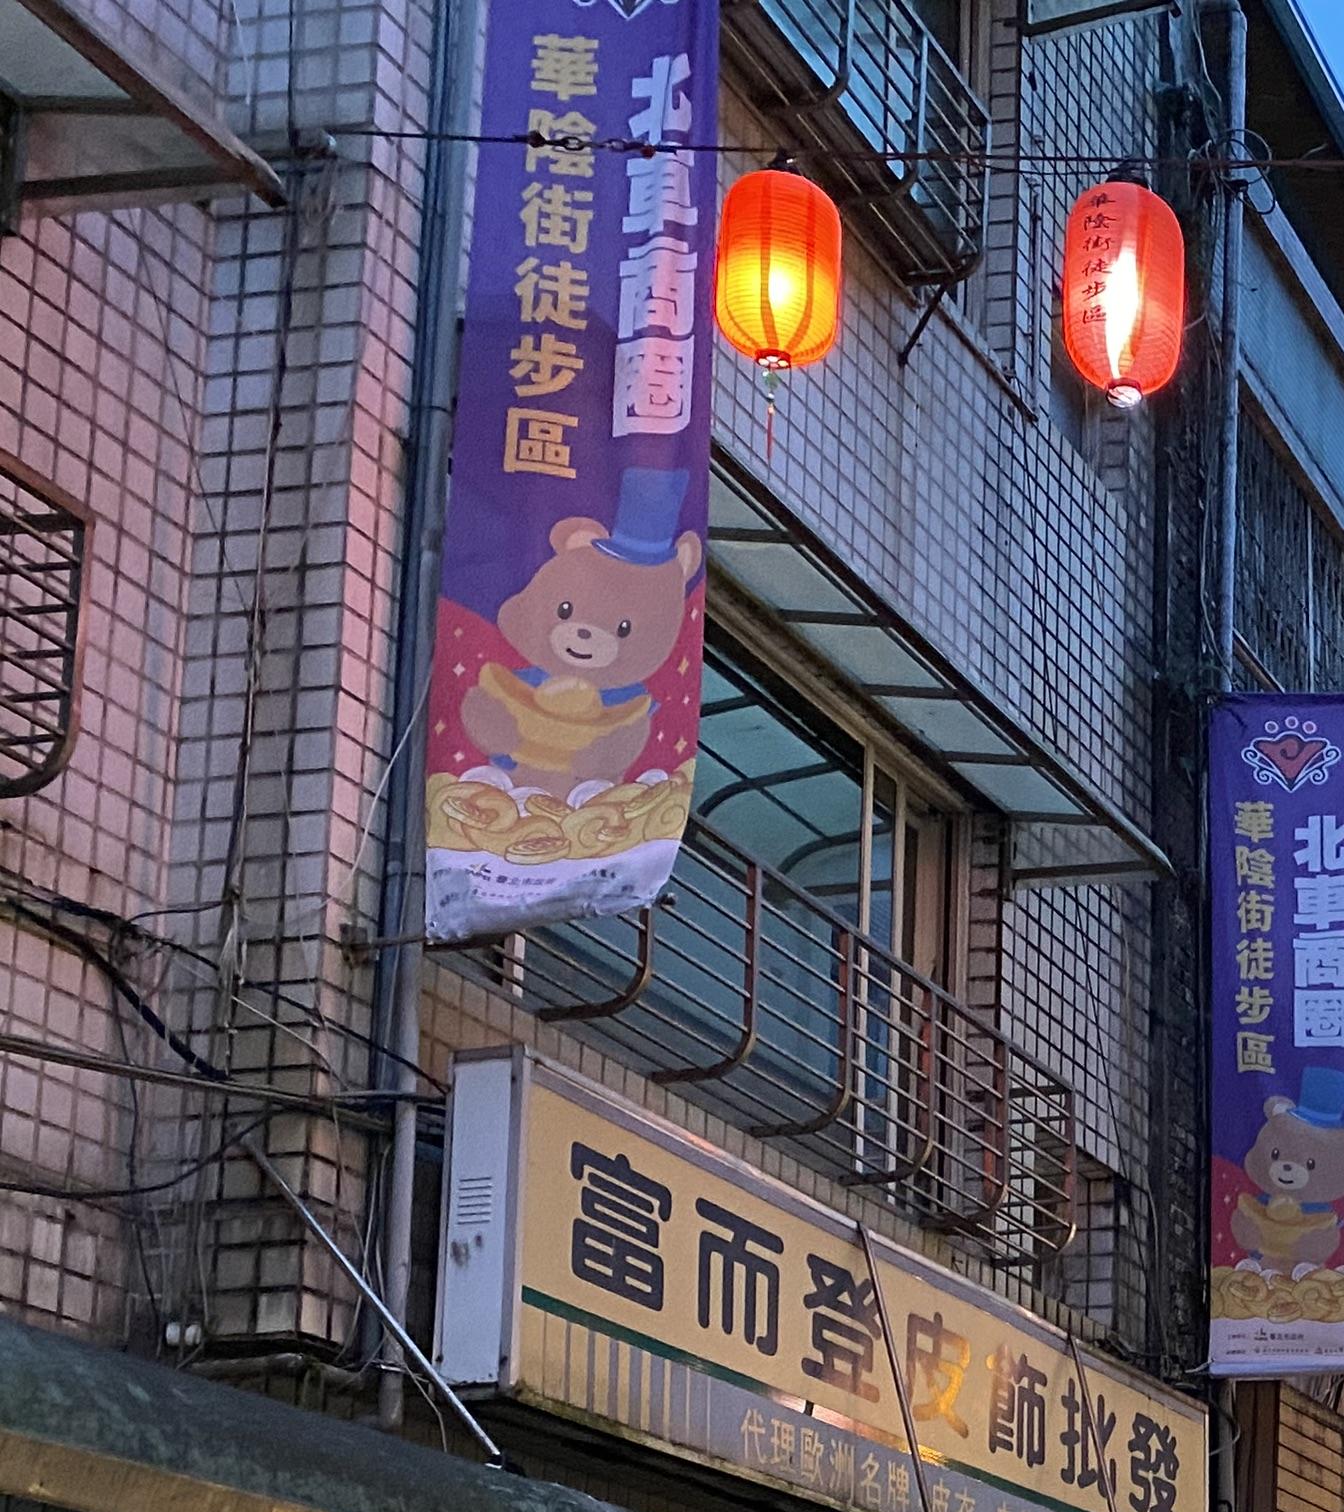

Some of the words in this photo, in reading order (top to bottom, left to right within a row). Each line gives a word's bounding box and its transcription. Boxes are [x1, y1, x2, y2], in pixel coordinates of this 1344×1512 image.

[504, 33, 599, 480] 華陰街徒步區
[612, 53, 698, 438] 北車商圈
[1234, 800, 1276, 1075] 華陰街徒步區
